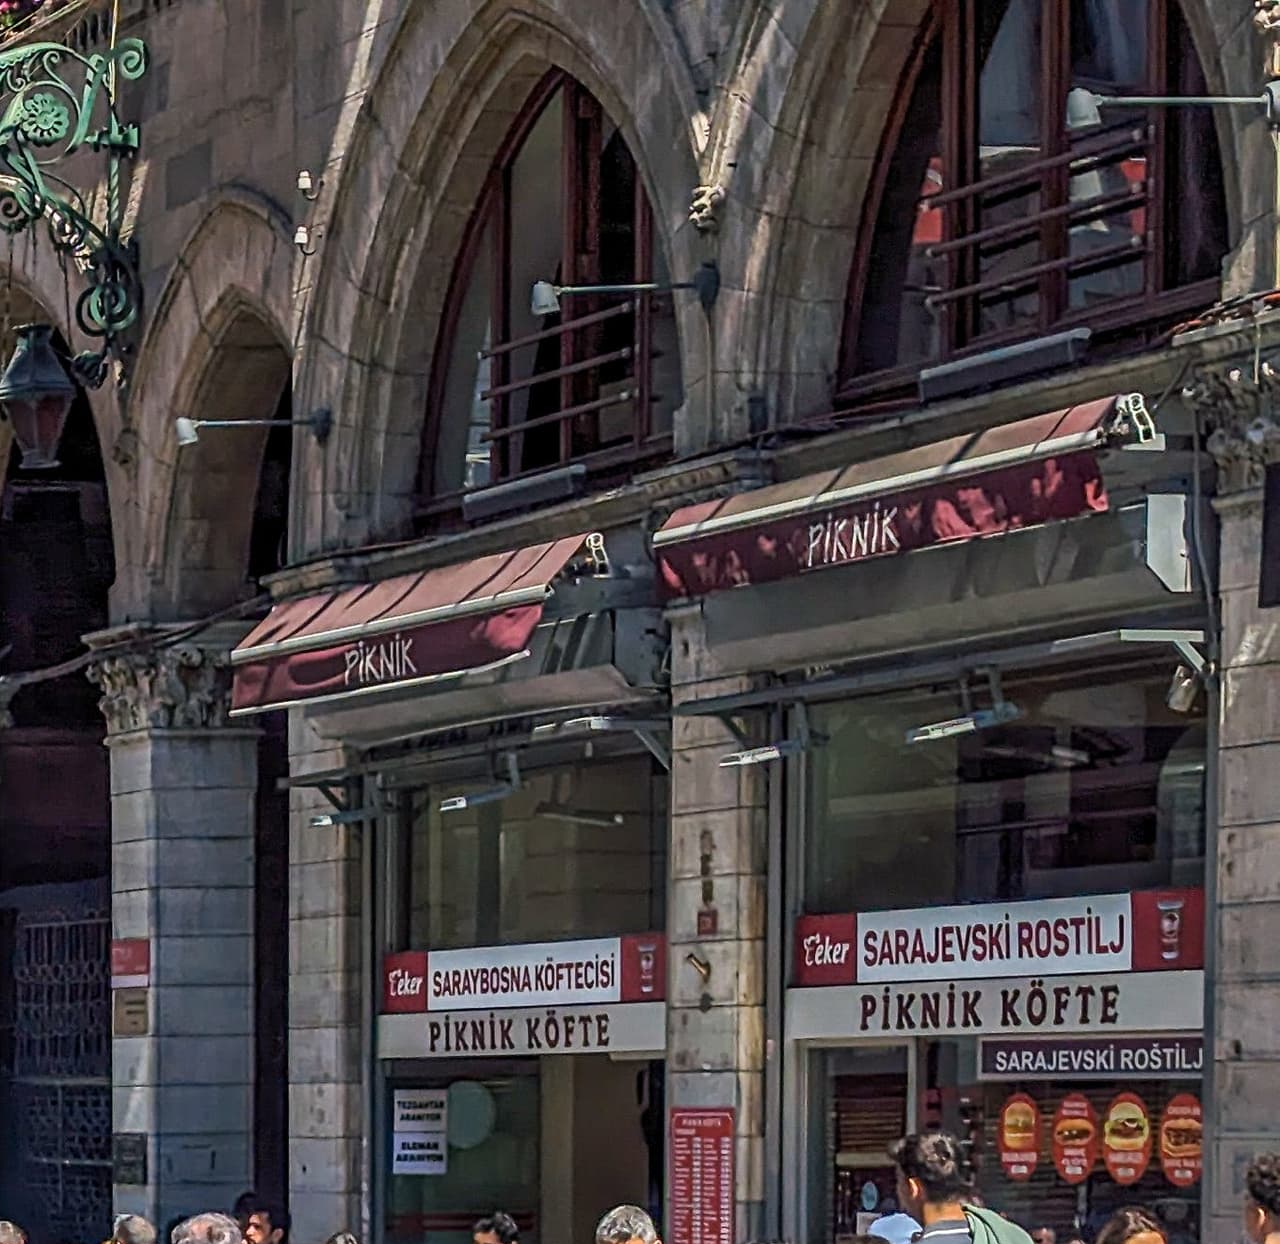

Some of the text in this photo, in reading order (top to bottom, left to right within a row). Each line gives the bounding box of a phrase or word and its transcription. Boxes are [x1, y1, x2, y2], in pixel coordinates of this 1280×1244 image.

[807, 501, 901, 567] PİKNİK
[344, 633, 417, 686] PİKNİK
[863, 906, 1125, 968] SARAJEVSKİ ROSTİLJ
[432, 952, 615, 998] SARAYBOSNA KÖFTECİSİ
[428, 1009, 611, 1052] PİKNİK KÖFTE
[859, 979, 1120, 1031] PİKNİK KÖFTE
[995, 1043, 1204, 1072] SARAJEVSKİ ROŠTİLJ
